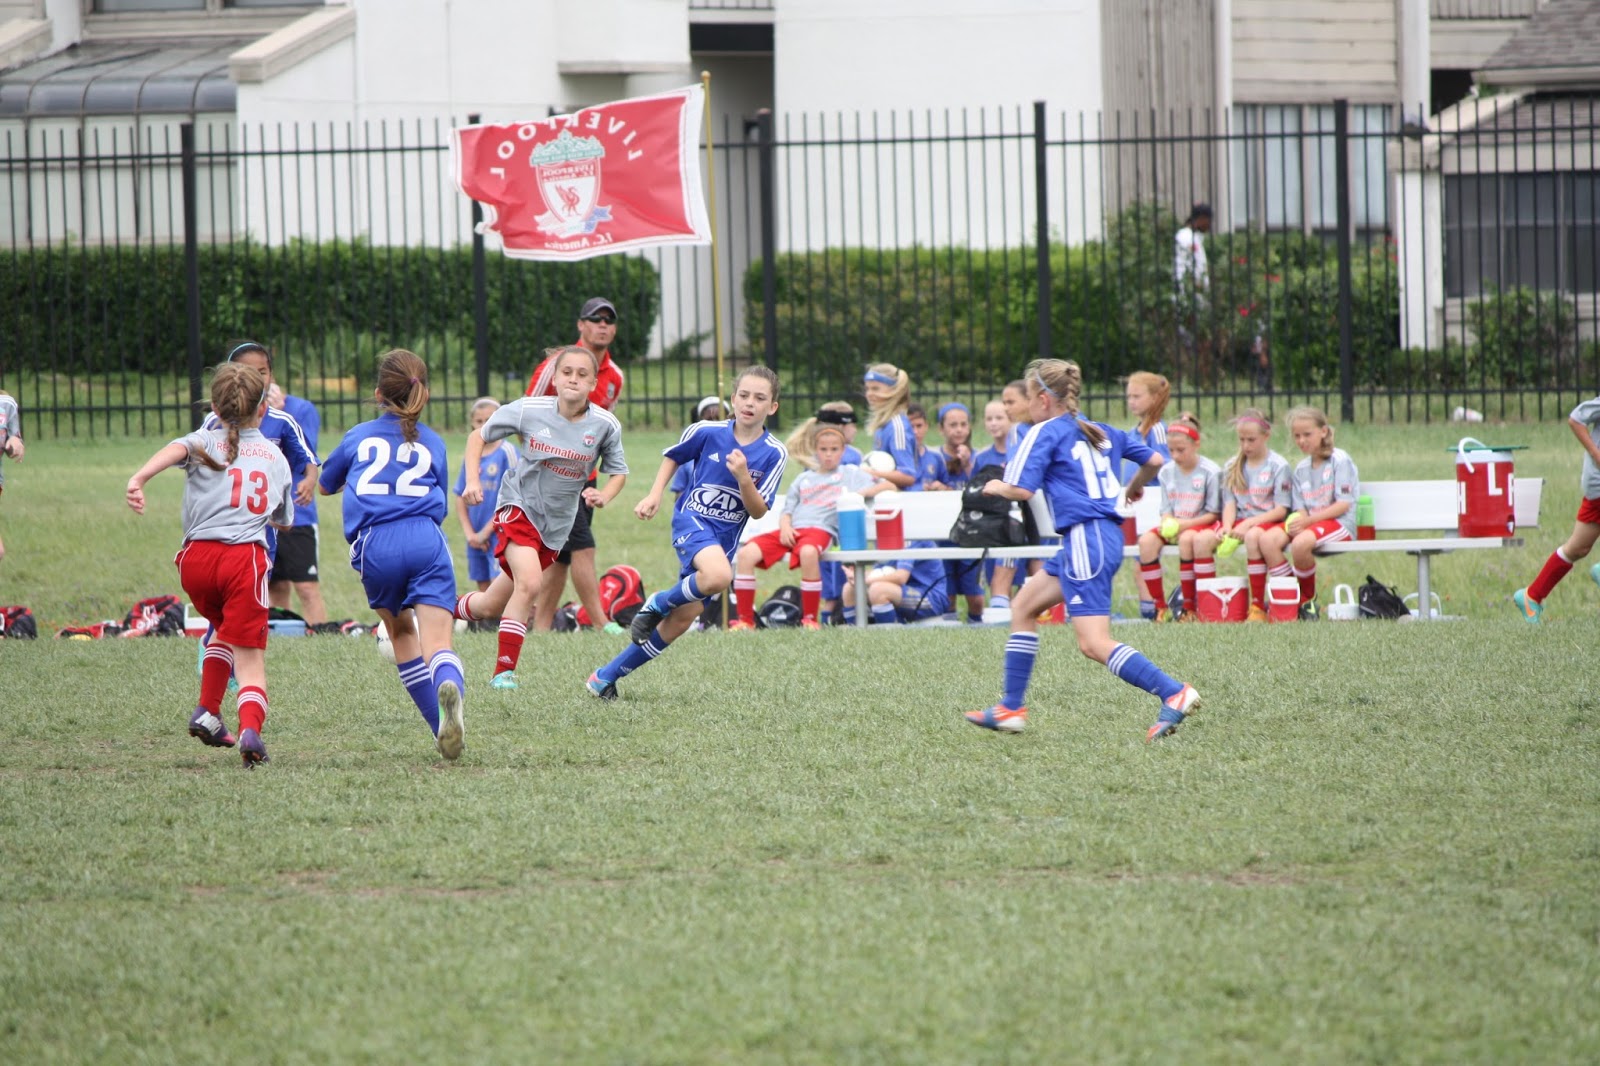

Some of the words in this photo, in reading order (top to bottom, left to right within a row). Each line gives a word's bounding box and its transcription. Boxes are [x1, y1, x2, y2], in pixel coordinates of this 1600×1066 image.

[356, 436, 432, 497] 22
[228, 467, 269, 515] 13
[688, 500, 742, 521] ADVOCARE
